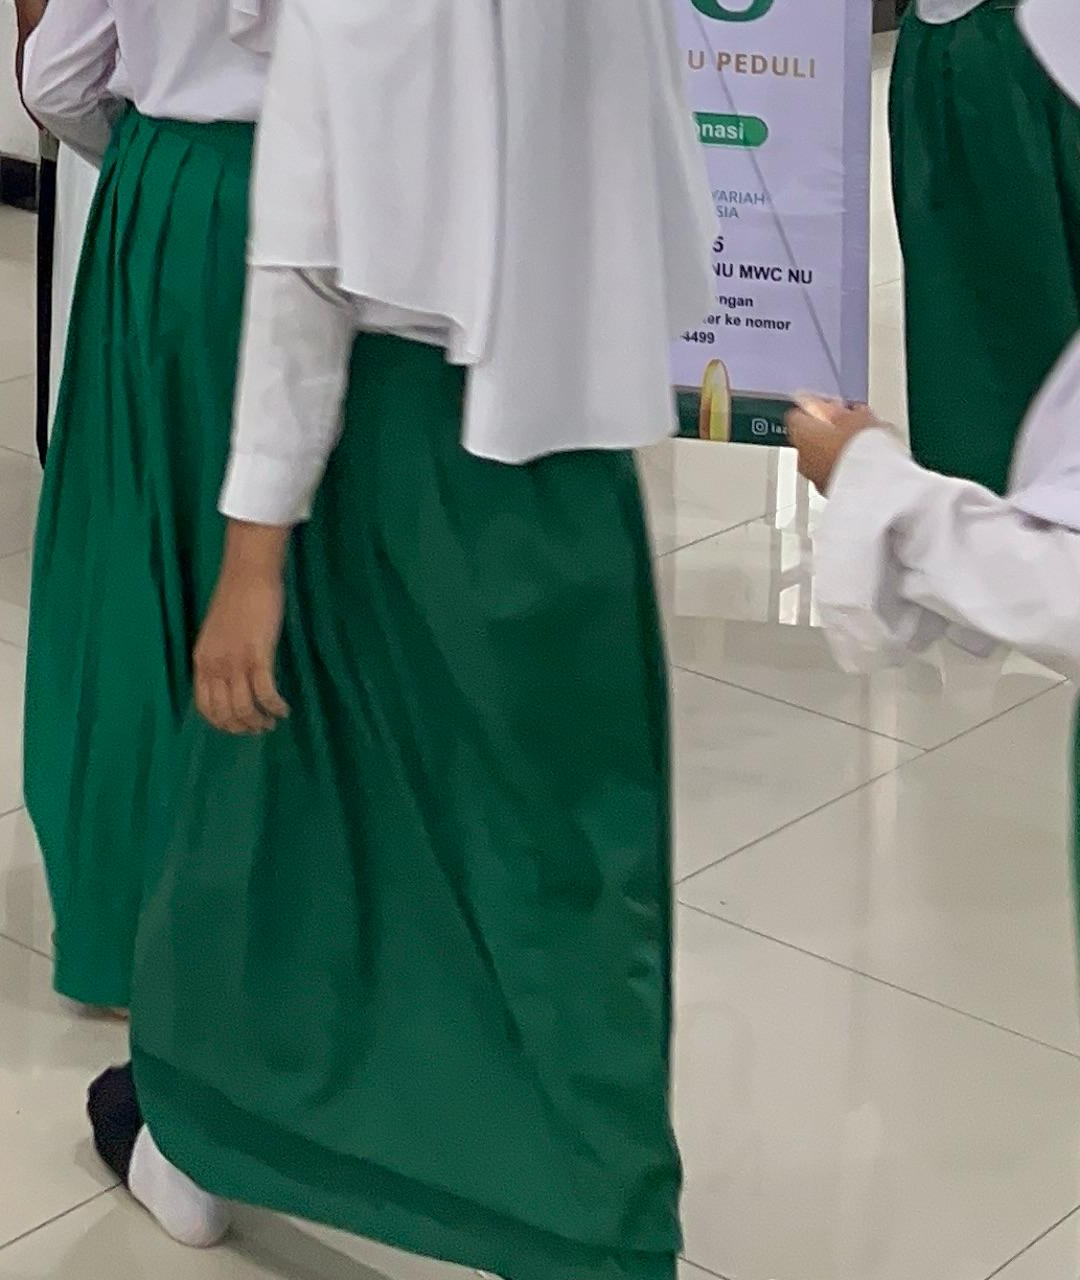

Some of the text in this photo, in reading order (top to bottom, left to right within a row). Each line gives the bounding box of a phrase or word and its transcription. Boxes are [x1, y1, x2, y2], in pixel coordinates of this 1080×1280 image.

[687, 49, 816, 79] U PEDULI
[716, 205, 739, 219] SIA
[739, 264, 783, 282] MWC
[787, 268, 813, 285] NU
[716, 294, 754, 309] ngan
[704, 313, 792, 331] er ke nomor
